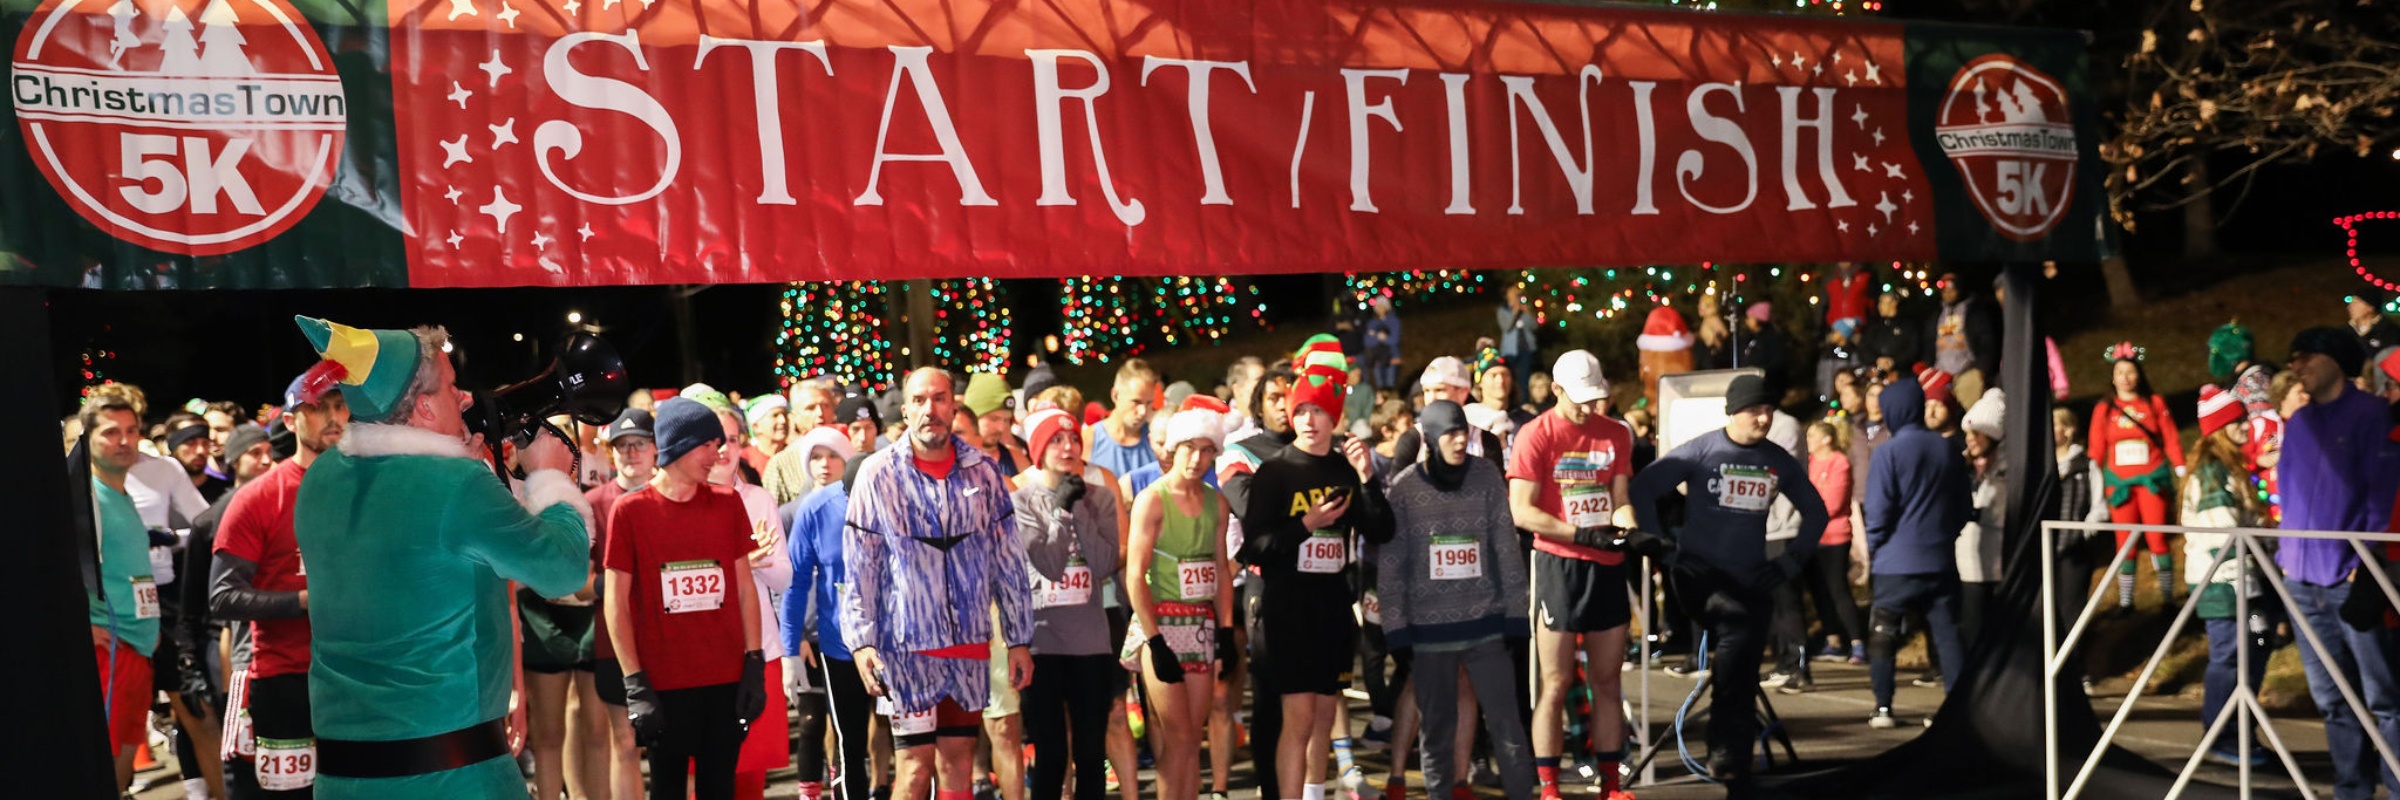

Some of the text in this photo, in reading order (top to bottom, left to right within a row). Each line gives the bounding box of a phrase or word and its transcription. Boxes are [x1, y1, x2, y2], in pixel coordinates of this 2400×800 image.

[13, 73, 345, 118] ChristmasTown
[1938, 129, 2077, 151] ChristmasTown
[119, 132, 267, 217] 5K
[1996, 160, 2049, 216] 5K
[1728, 480, 1767, 498] 1678
[1570, 497, 1609, 515] 2422
[1434, 548, 1477, 565] 1996
[668, 574, 720, 597] 1332
[1183, 566, 1215, 585] 2195
[260, 753, 312, 775] 2139
